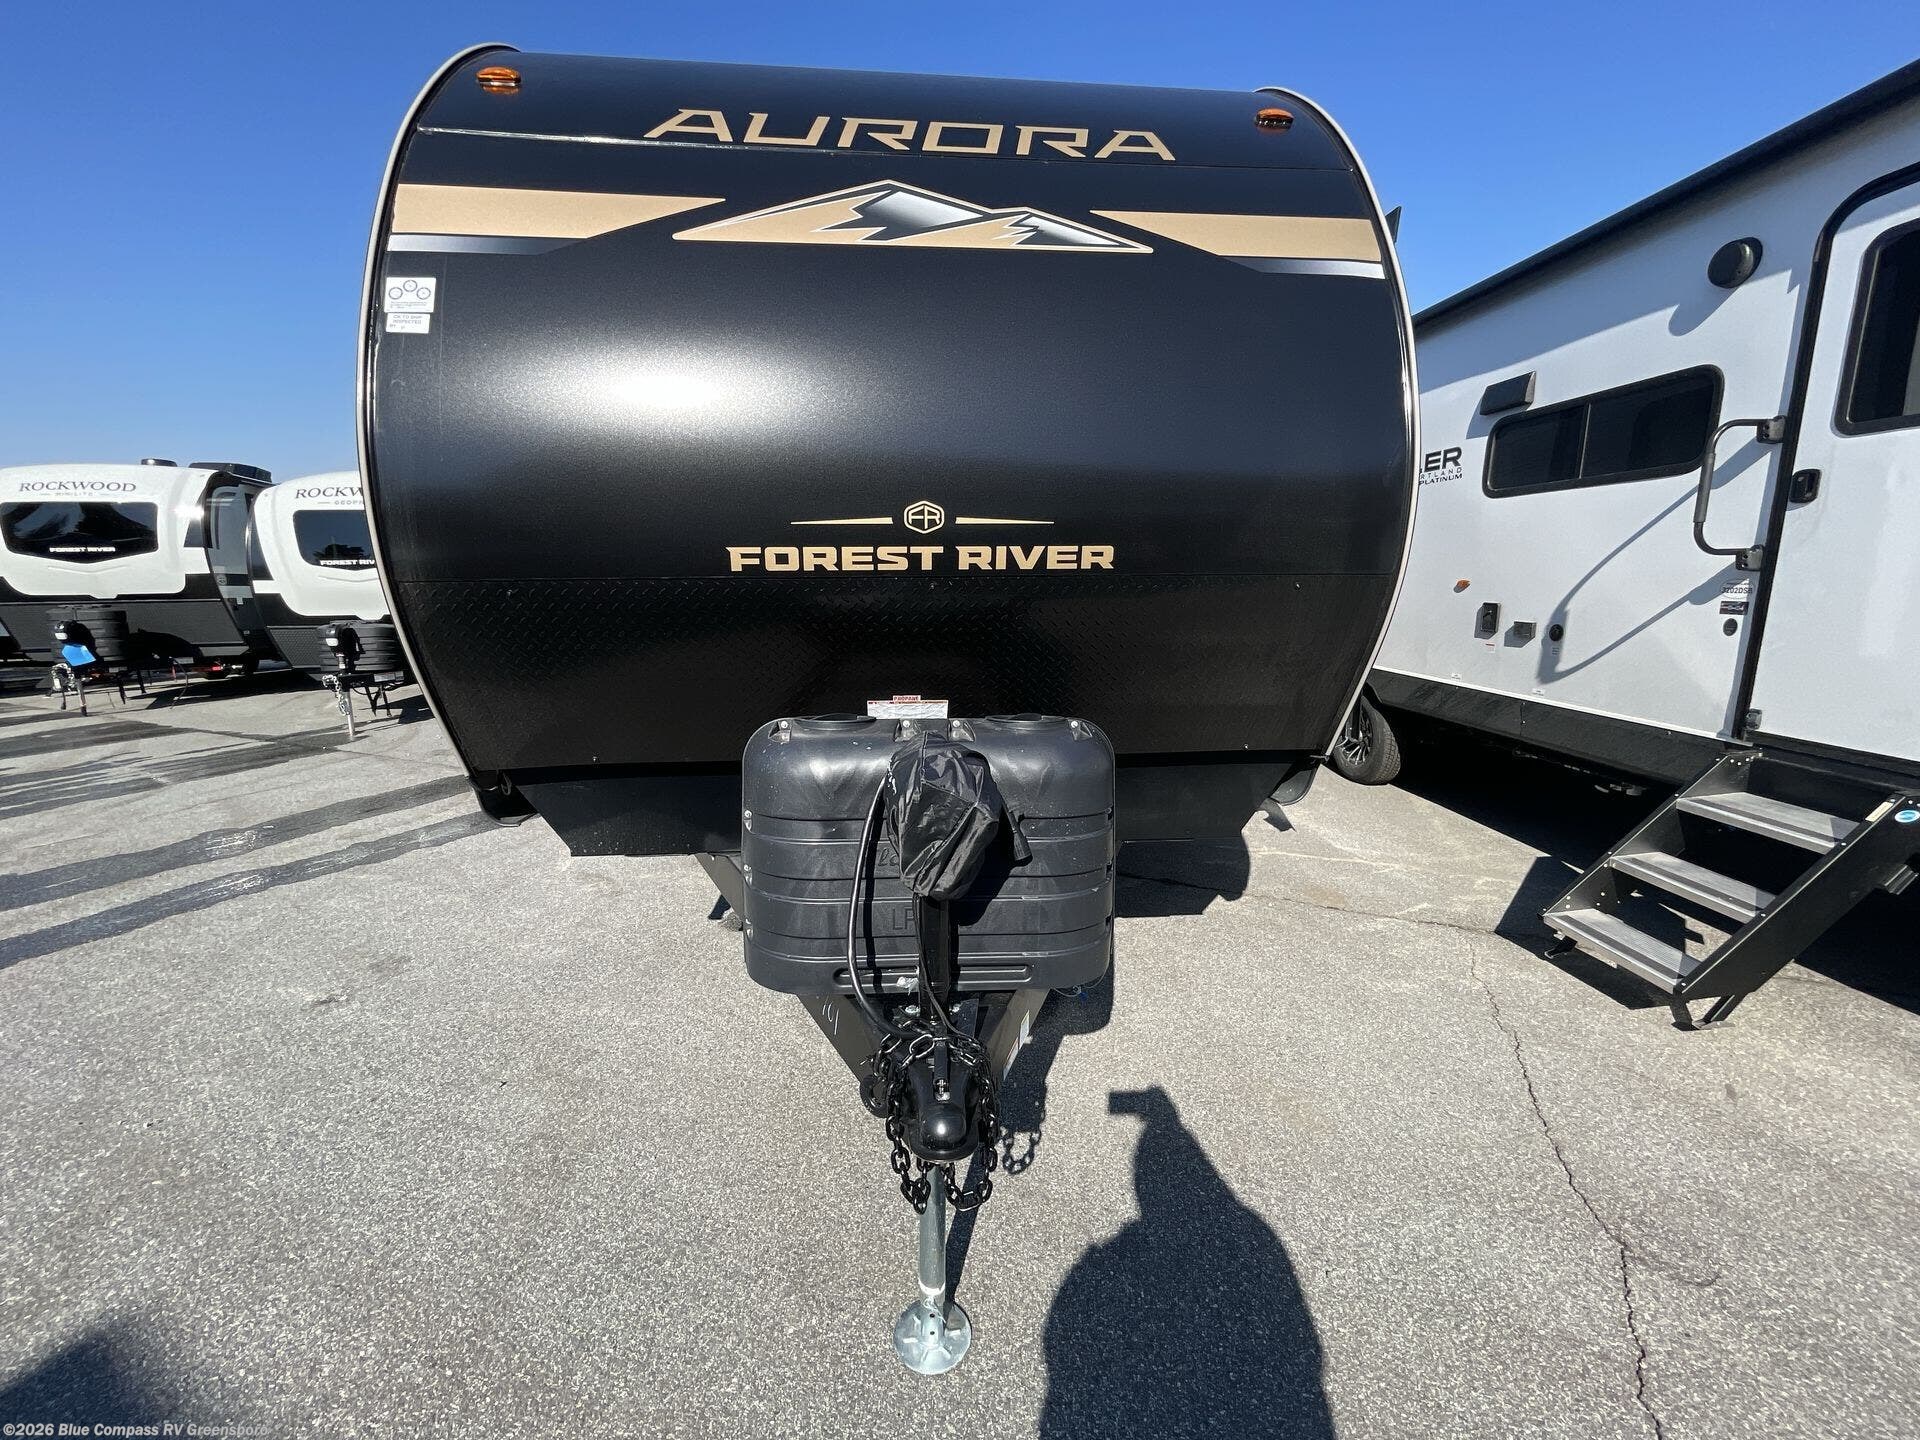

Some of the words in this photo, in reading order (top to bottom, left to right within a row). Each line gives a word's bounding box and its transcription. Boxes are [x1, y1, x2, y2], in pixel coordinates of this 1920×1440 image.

[643, 109, 1176, 161] AURORA
[1420, 446, 1463, 473] ER
[1419, 473, 1463, 486] PLATINUM
[1420, 467, 1463, 479] RTLAND
[19, 481, 137, 492] ROCKWOOD
[295, 487, 364, 499] ROCKW
[725, 546, 944, 572] FOREST
[955, 545, 1114, 570] RIVER
